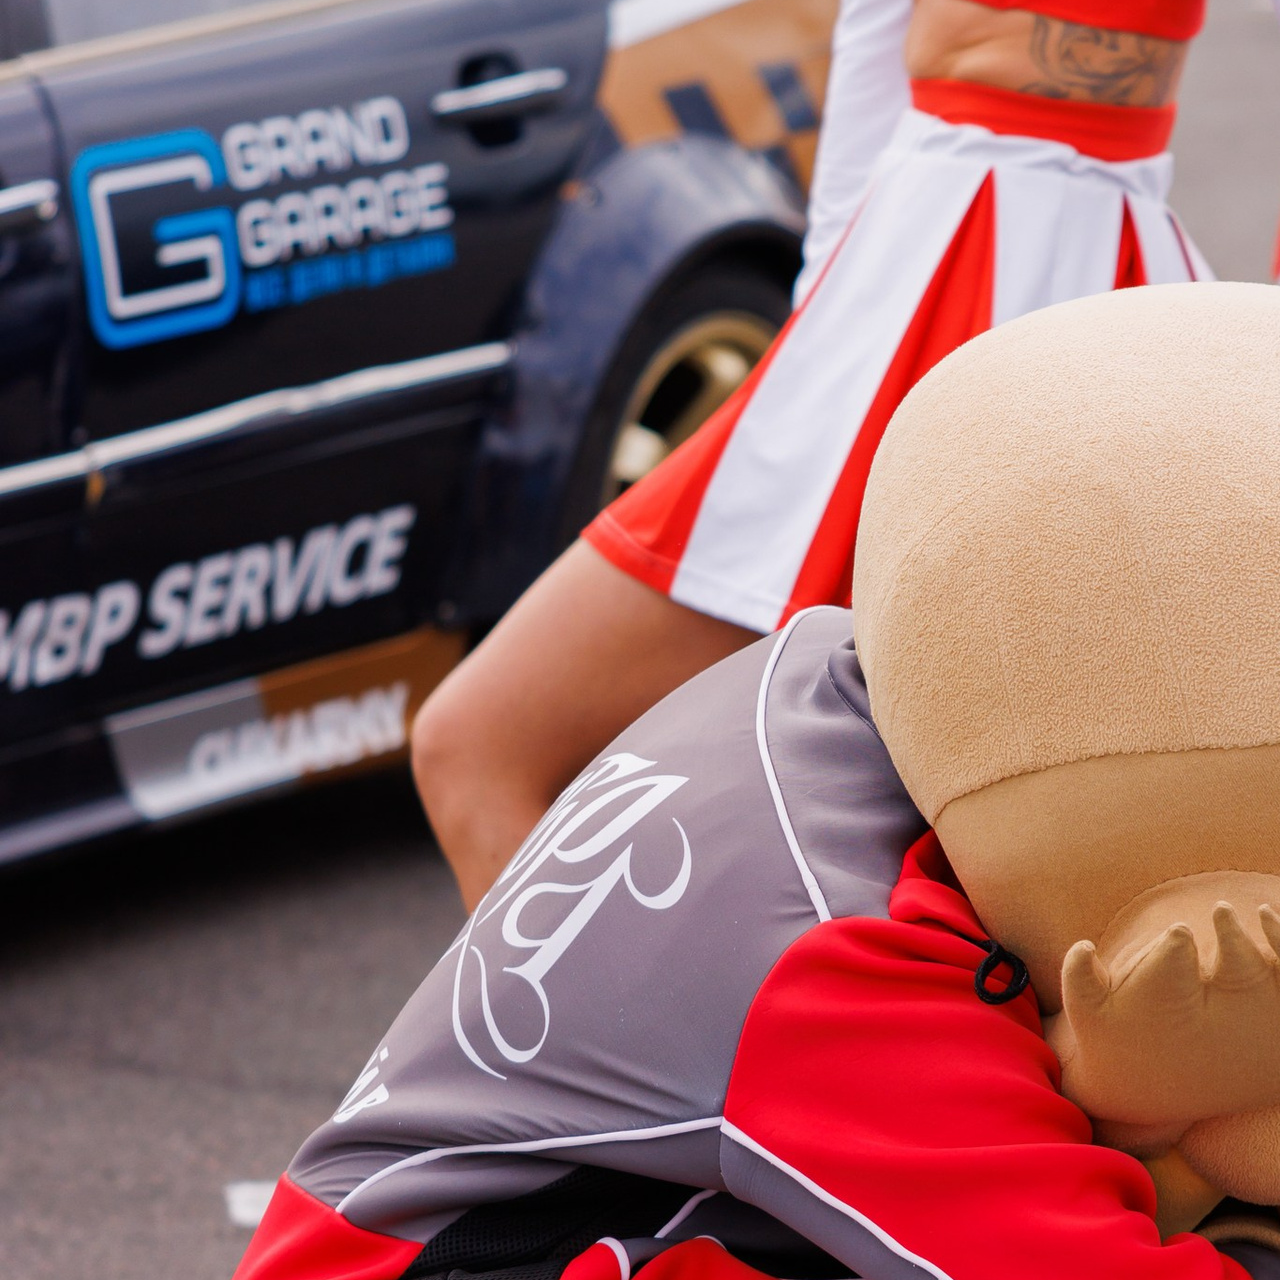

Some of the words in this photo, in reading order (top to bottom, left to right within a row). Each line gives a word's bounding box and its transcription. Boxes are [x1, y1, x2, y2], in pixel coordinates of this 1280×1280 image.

[220, 94, 411, 192] GRAND
[236, 161, 456, 269] GARAGE
[136, 503, 417, 660] SERVICE
